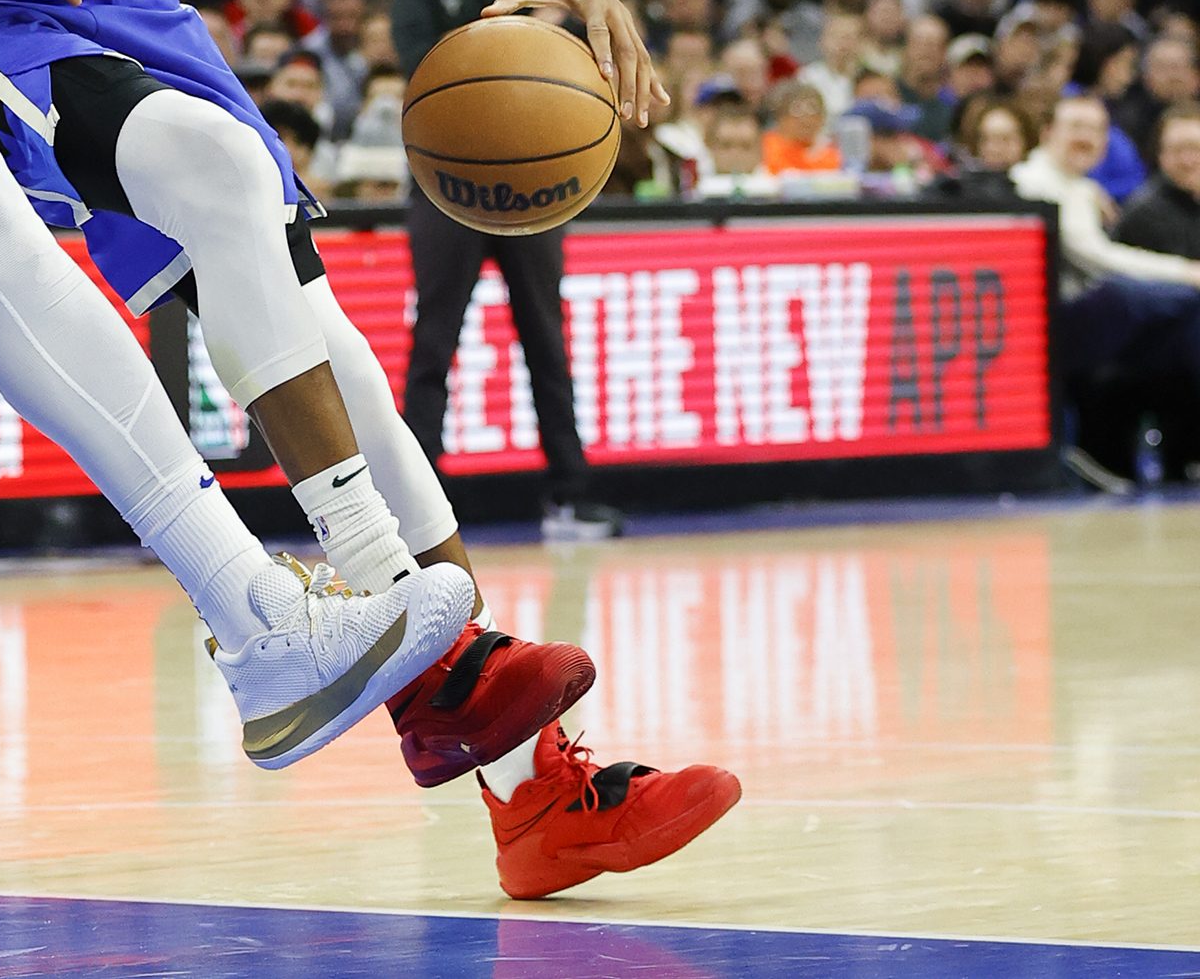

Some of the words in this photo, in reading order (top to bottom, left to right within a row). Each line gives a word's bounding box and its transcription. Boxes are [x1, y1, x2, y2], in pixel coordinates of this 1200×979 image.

[434, 169, 582, 212] Wilson
[558, 268, 701, 450] THE
[712, 261, 872, 446] NEW
[887, 266, 1007, 434] APP
